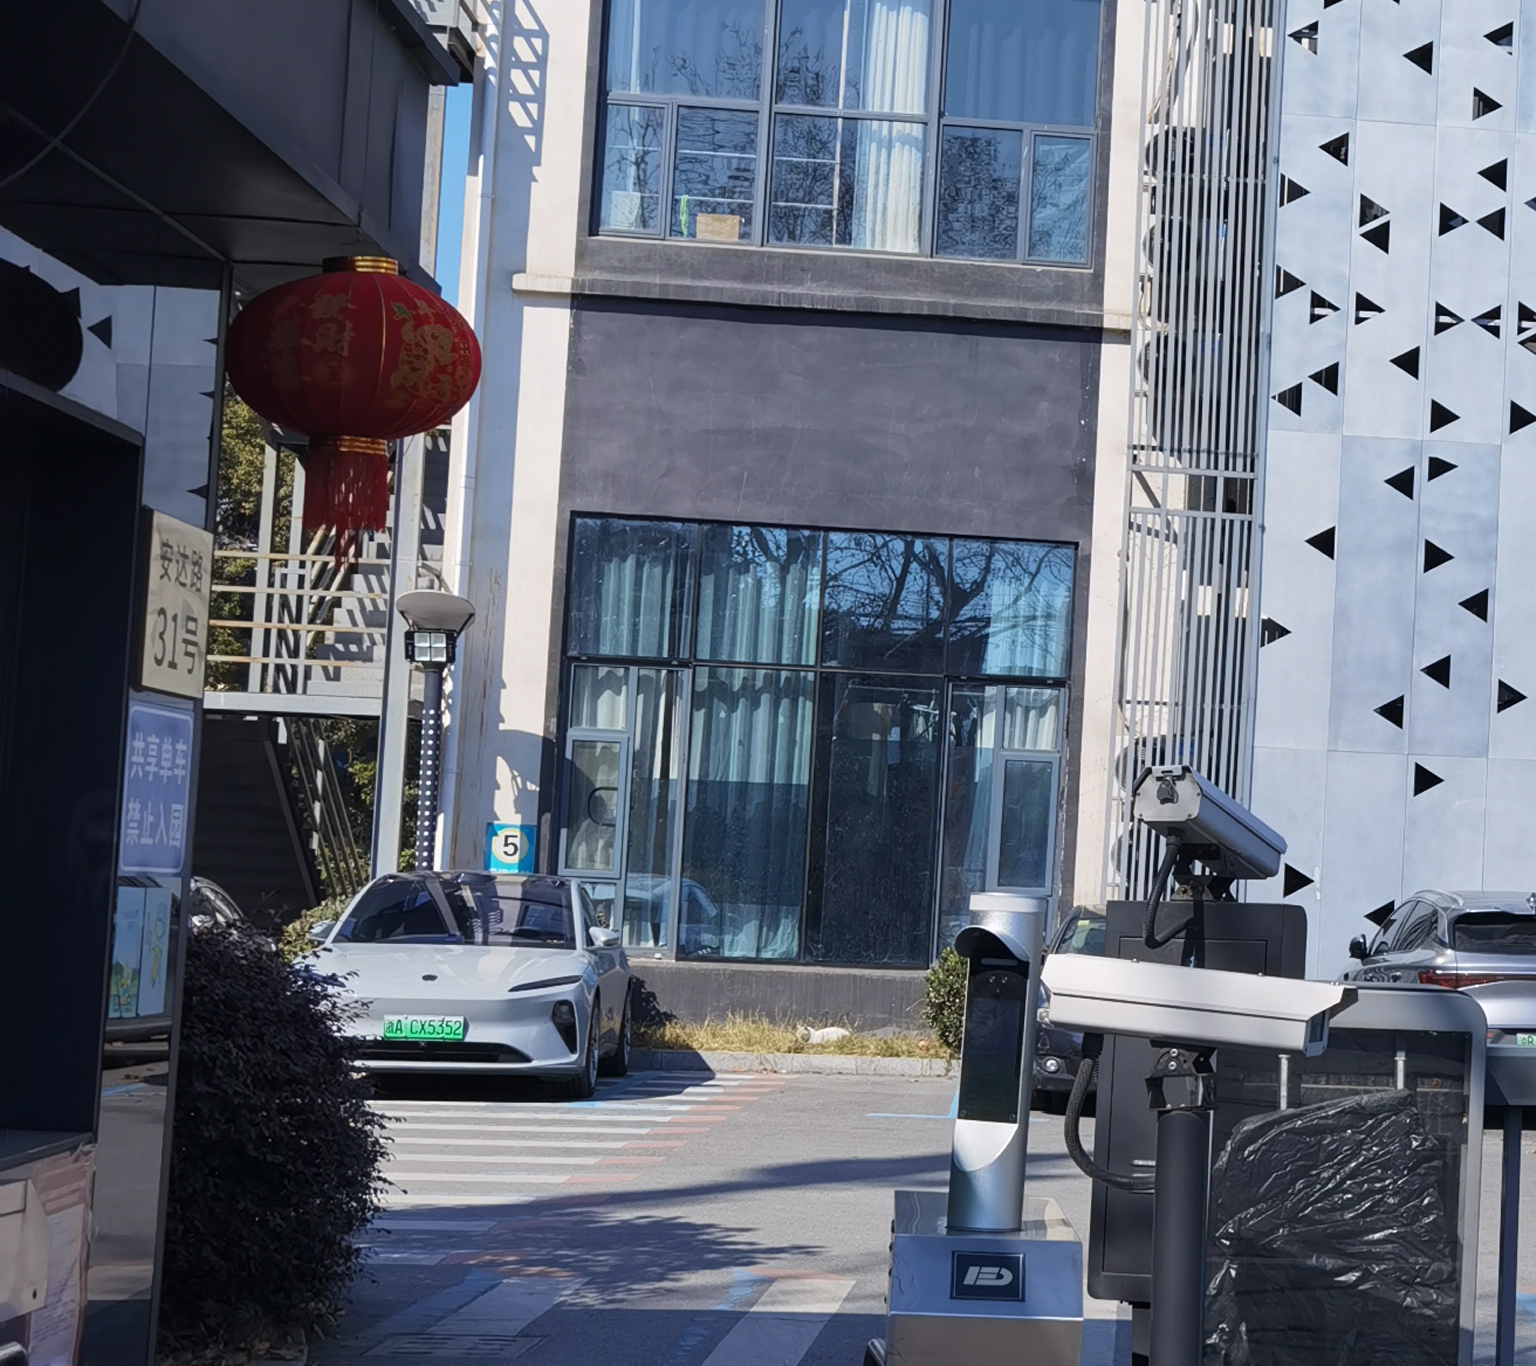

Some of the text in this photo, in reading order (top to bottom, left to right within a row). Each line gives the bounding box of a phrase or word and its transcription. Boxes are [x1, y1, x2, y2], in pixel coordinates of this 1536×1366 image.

[160, 538, 203, 593] 安达路
[153, 606, 198, 674] 31号
[130, 732, 187, 785] 共享单车
[126, 797, 183, 848] 禁止入园
[503, 835, 519, 856] 5
